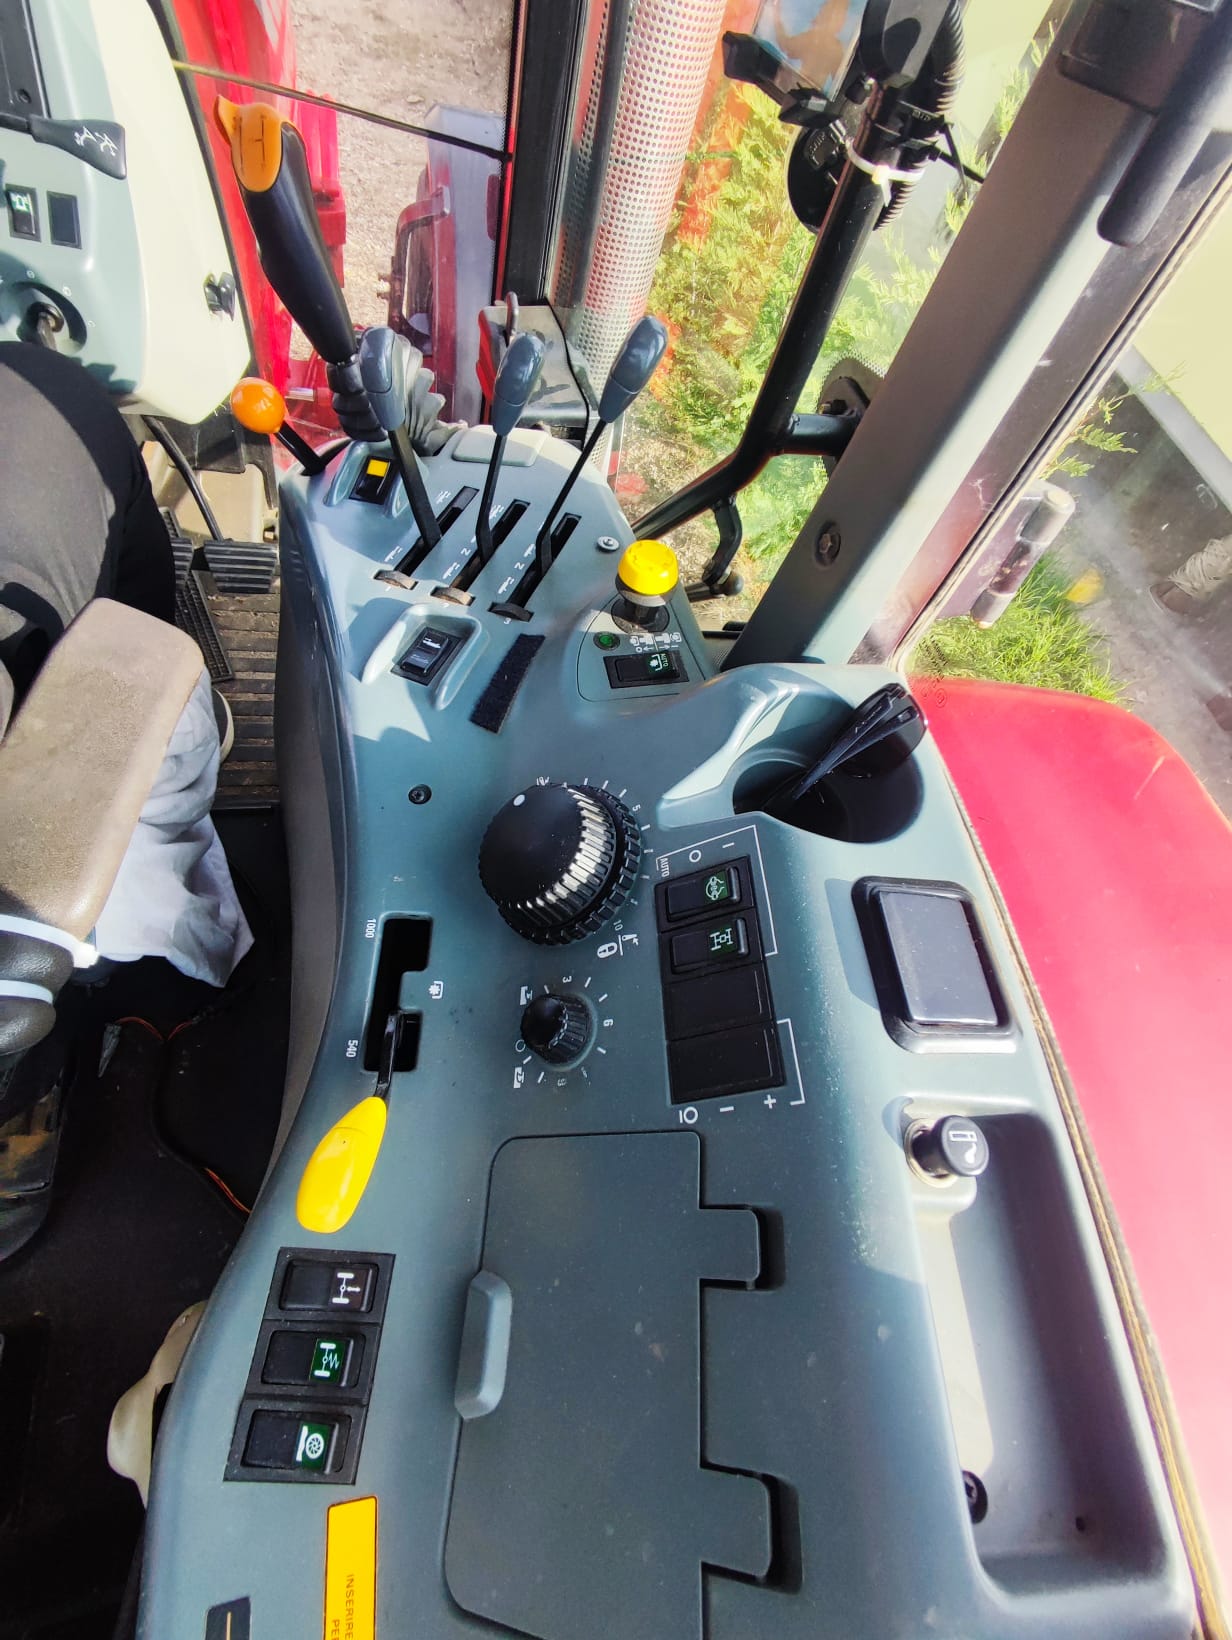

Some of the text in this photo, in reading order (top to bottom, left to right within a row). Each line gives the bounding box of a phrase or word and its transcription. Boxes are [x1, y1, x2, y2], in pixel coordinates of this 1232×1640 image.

[660, 653, 669, 667] AUTO
[632, 804, 641, 812] 5
[659, 857, 670, 877] AUTO
[365, 919, 376, 938] 1000
[613, 919, 623, 931] 10
[562, 975, 572, 983] 3
[603, 1018, 614, 1027] 6
[346, 1040, 358, 1057] 540
[345, 1574, 354, 1640] INSERIRE
